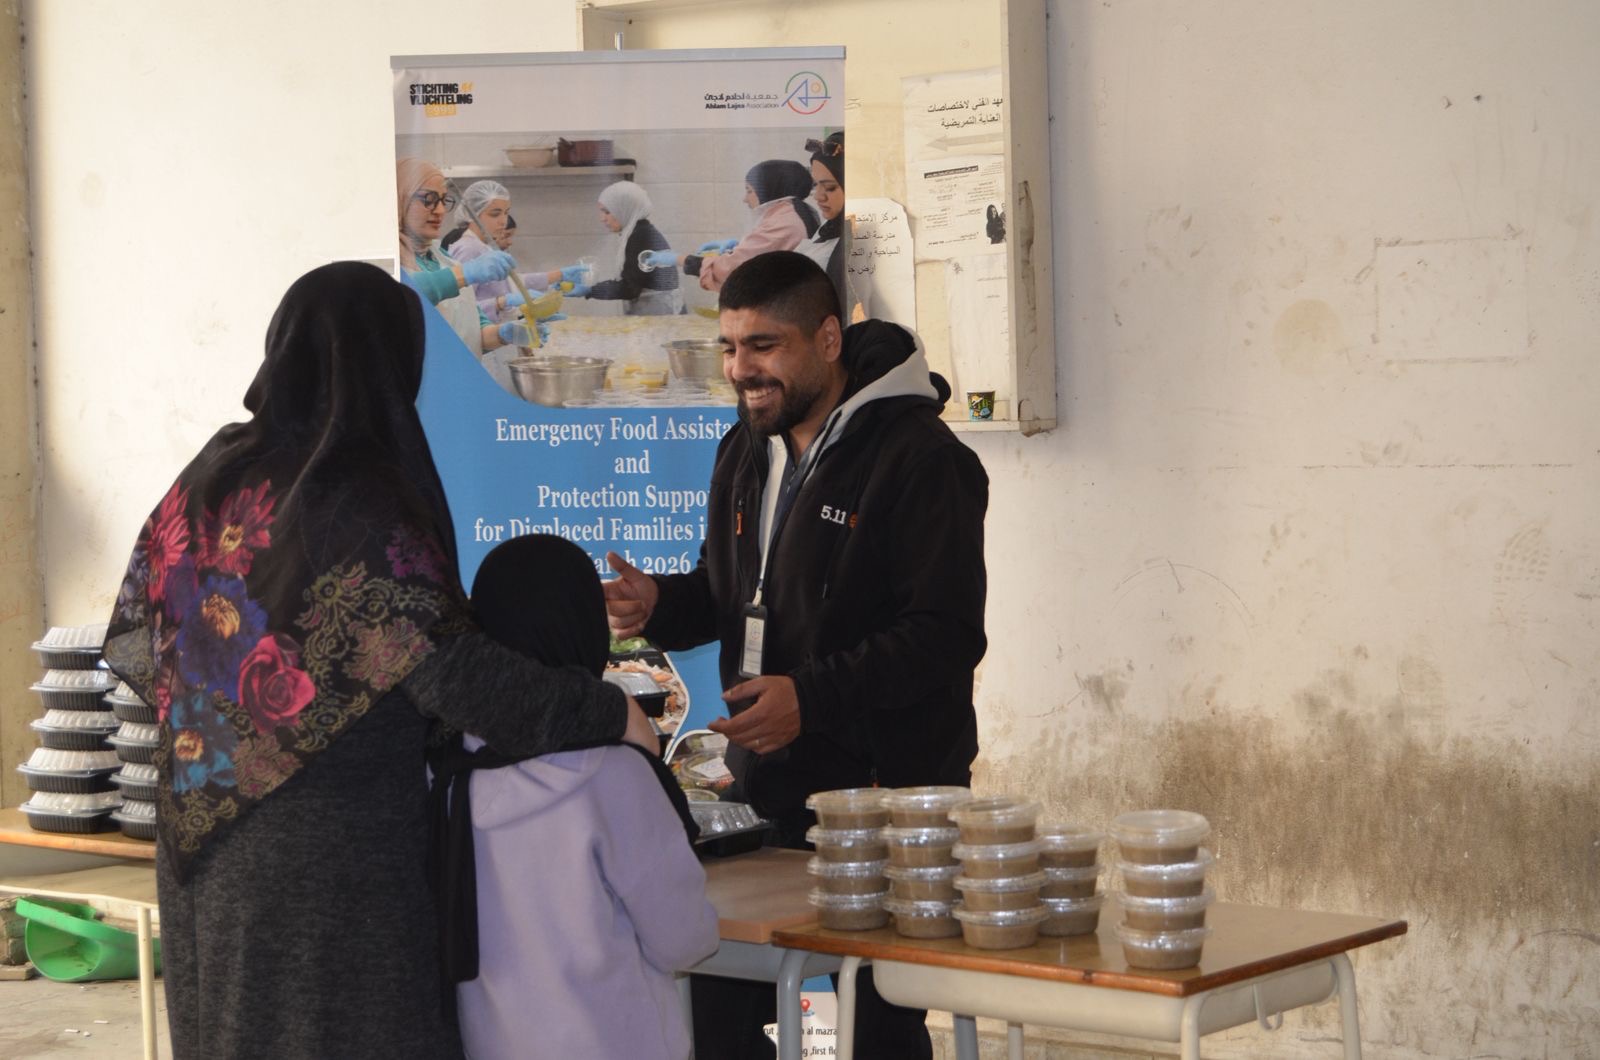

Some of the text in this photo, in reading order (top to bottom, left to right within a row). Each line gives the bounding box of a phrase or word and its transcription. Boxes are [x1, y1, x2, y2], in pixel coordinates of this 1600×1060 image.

[410, 83, 458, 94] STICHTING
[410, 94, 473, 105] VLUCHTELING
[880, 212, 898, 224] مركز
[495, 415, 735, 447] Emergency Food Assista
[614, 449, 651, 474] and
[537, 483, 710, 514] Protection Suppo
[820, 504, 847, 525] 5.11
[474, 517, 504, 542] for
[610, 516, 694, 541] Families
[698, 516, 708, 541] i
[587, 549, 691, 575] arh 2026
